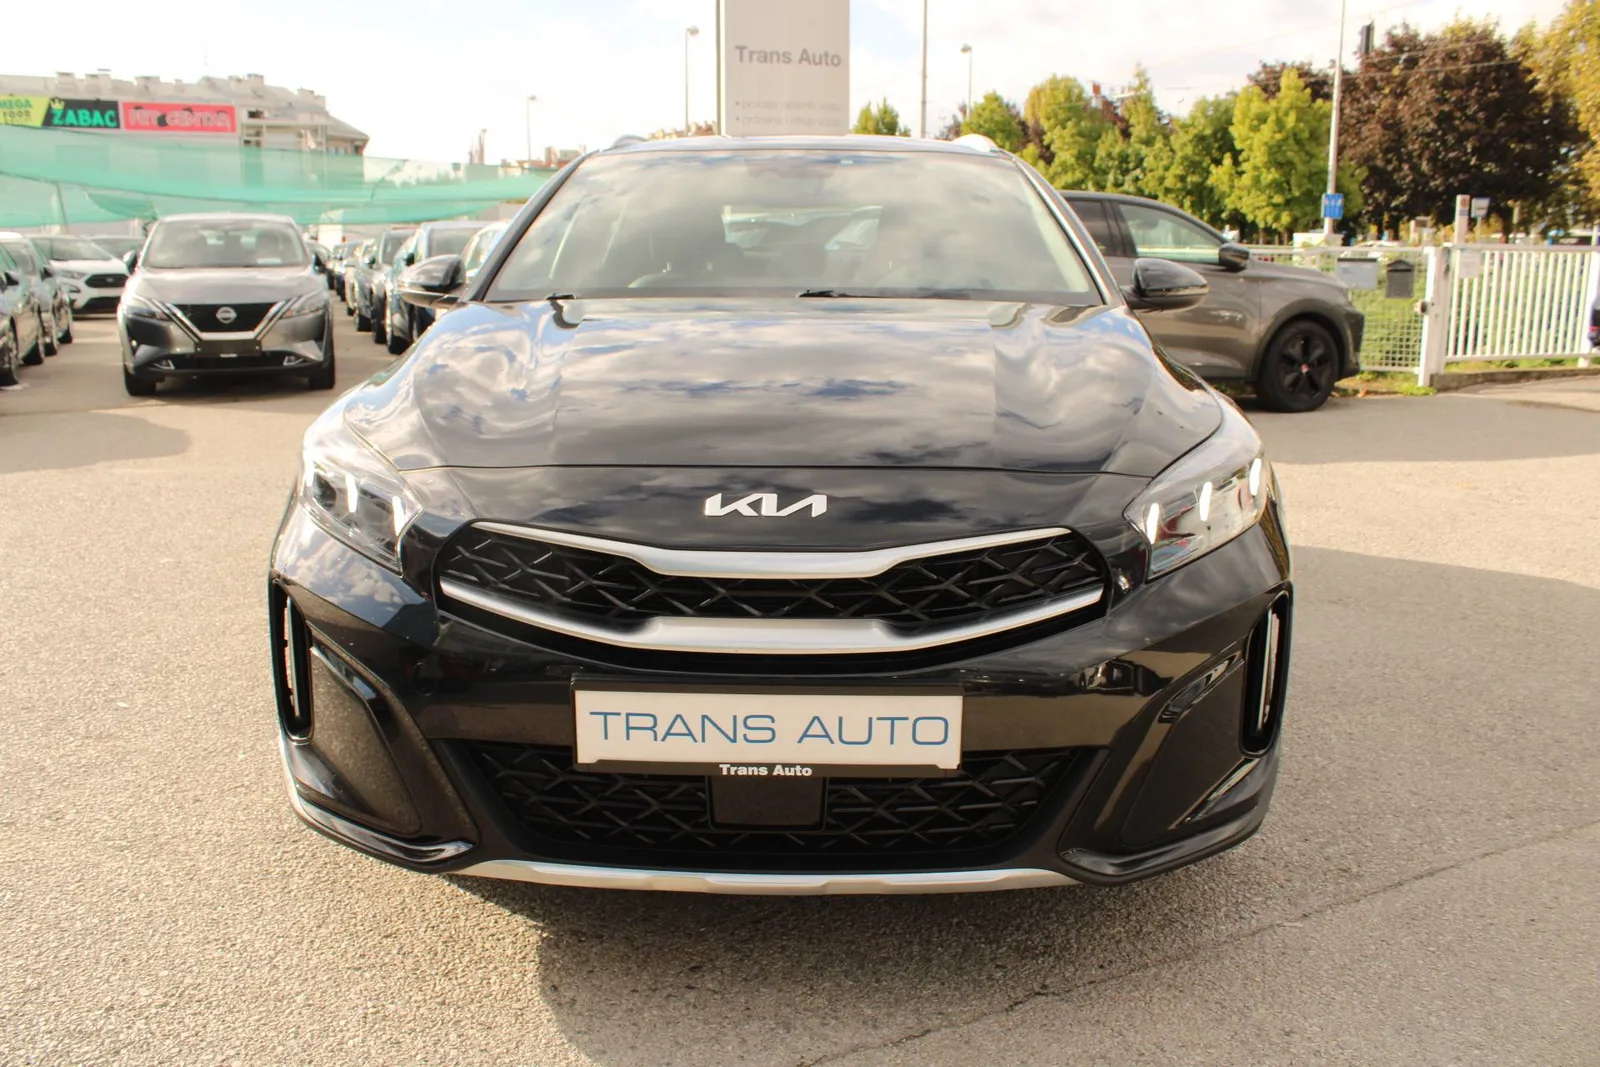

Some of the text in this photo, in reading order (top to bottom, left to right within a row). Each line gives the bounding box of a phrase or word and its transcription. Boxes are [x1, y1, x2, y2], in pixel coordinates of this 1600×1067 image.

[734, 45, 842, 67] Trans Auto
[589, 711, 950, 746] TRANS AUTO
[718, 763, 813, 777] Trans Auto
